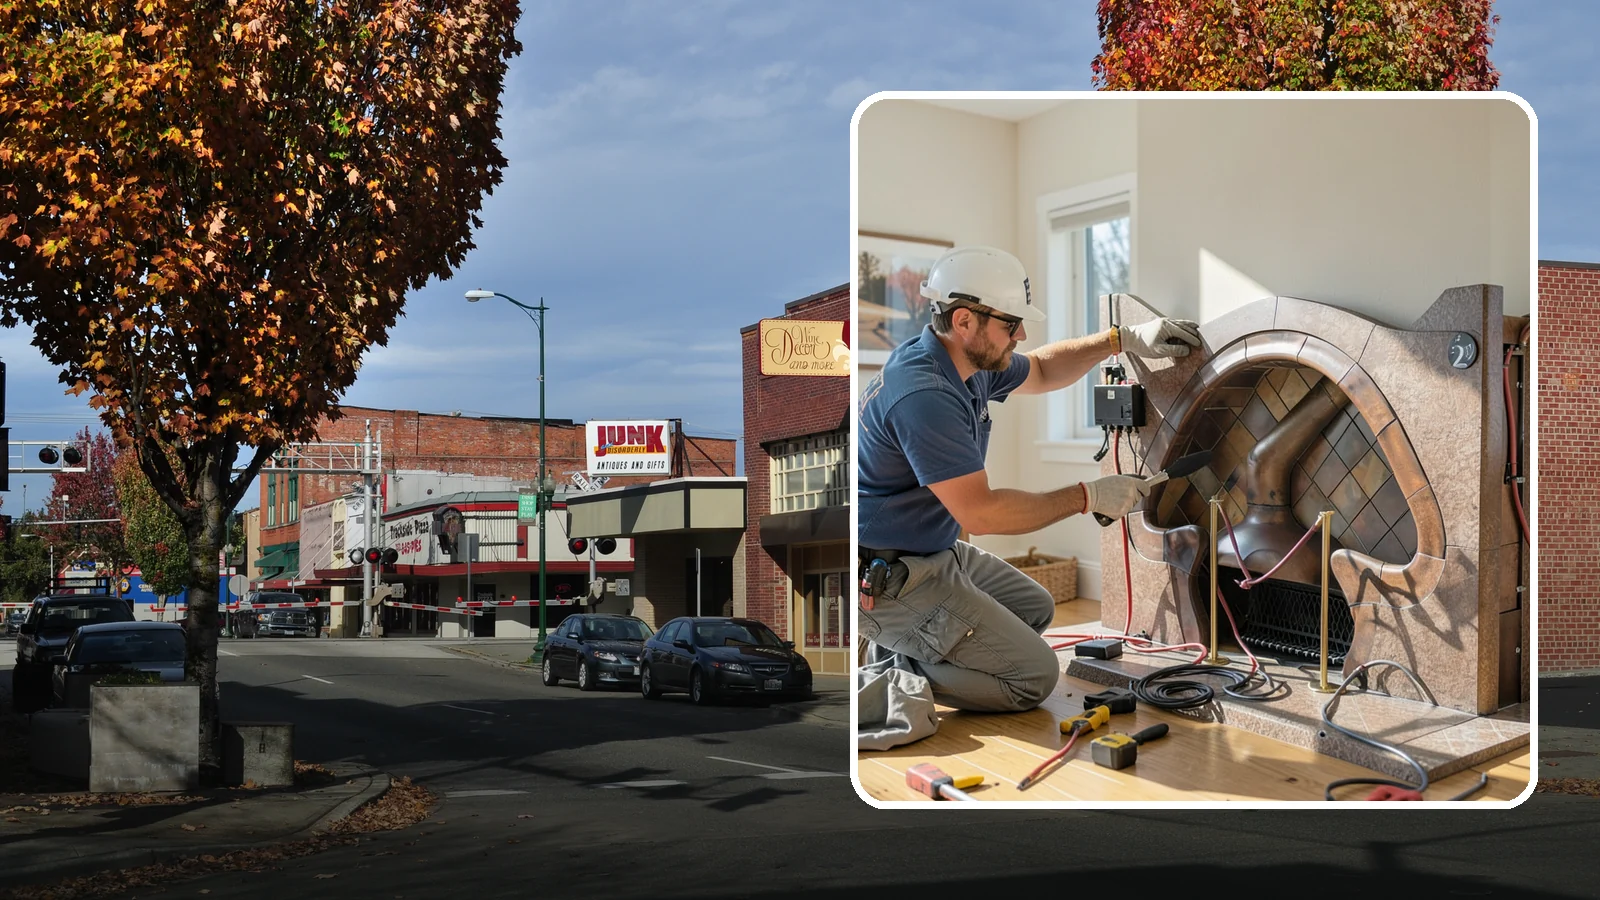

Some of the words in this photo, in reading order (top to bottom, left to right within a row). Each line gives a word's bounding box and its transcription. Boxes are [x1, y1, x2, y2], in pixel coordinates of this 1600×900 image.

[765, 327, 831, 365] Decor
[595, 425, 665, 457] JUNK
[607, 446, 646, 454] DISORDERLY
[597, 461, 628, 470] ANTIQUES
[631, 461, 643, 470] AND
[647, 460, 665, 470] GIFTS
[414, 519, 429, 534] Pizza
